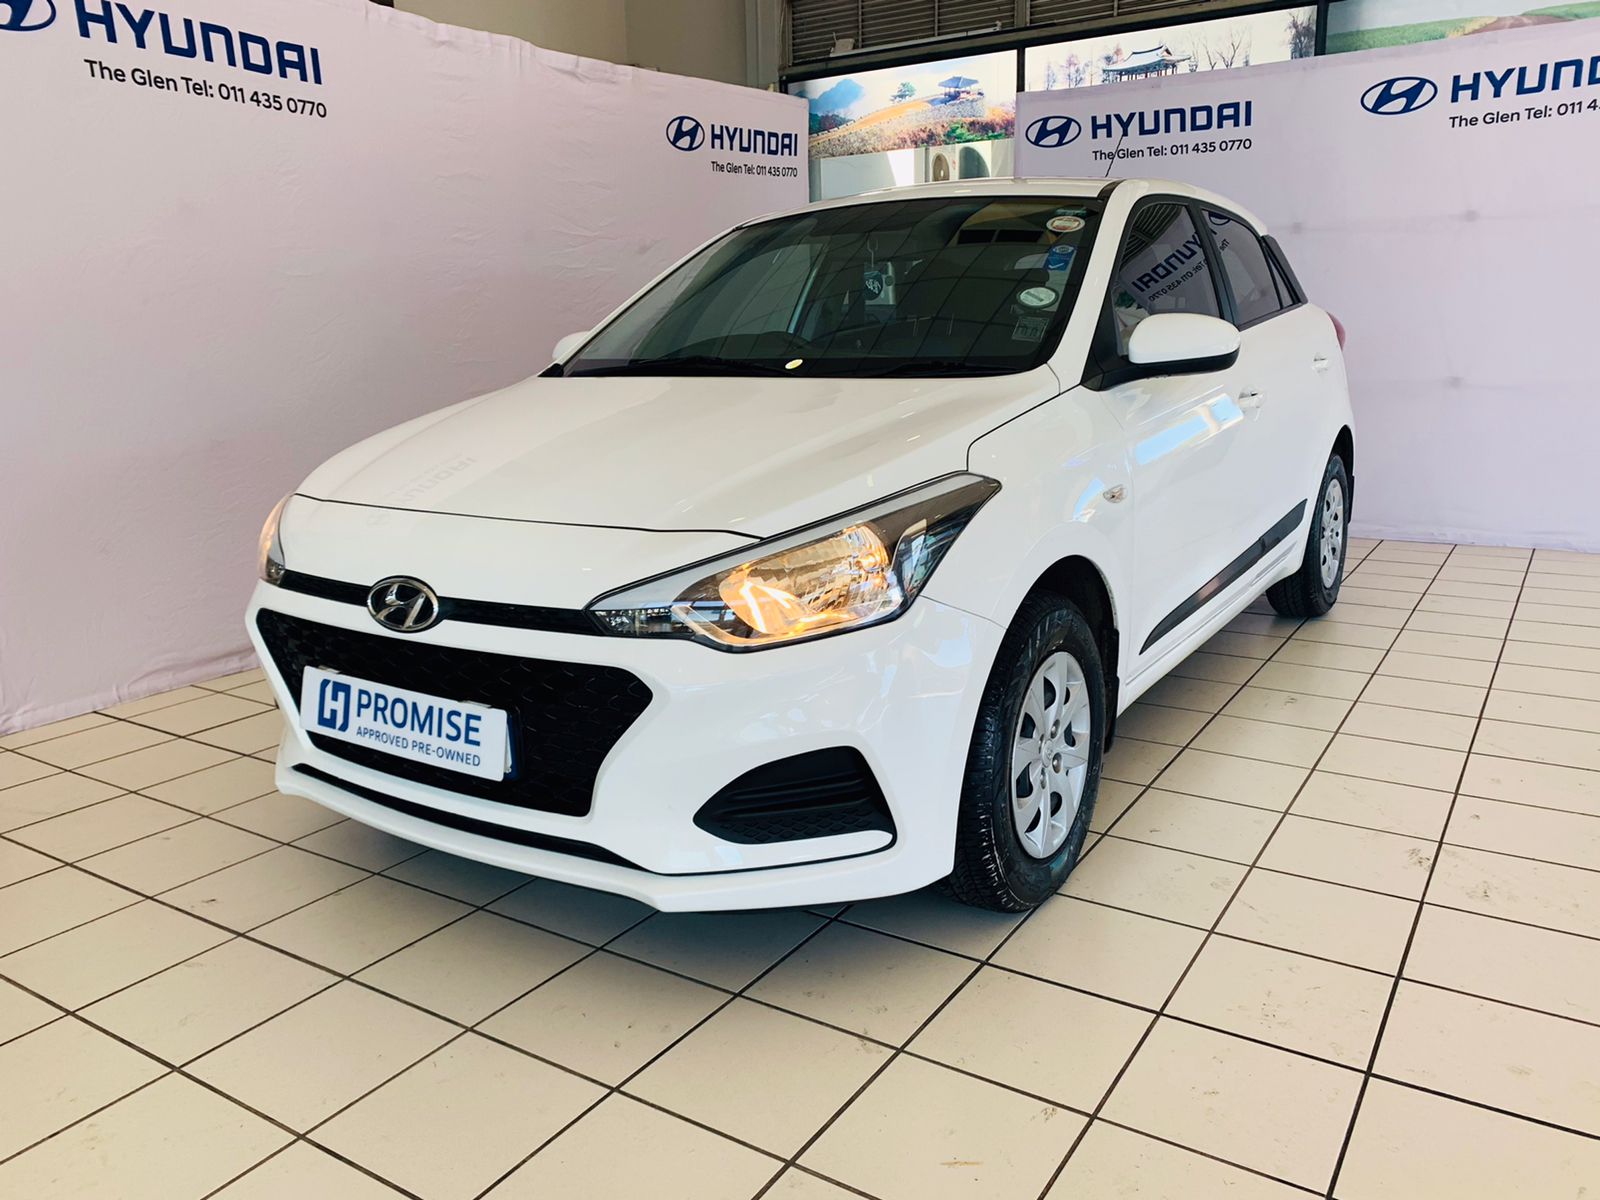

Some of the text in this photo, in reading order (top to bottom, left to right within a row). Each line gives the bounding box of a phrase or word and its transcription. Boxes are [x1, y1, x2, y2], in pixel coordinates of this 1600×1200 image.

[74, 0, 322, 85] HYUNDAI
[83, 58, 328, 118] The Glen Tel: 011 435 0770
[1091, 100, 1252, 140] HYUNDAI
[1449, 97, 1600, 129] The Glen Tel: 011 4
[711, 123, 798, 157] HYUNDAI
[1092, 138, 1252, 161] The Glen Tel: 011 435 0770
[711, 161, 798, 178] The Glen Tel: 011 435 0770
[356, 688, 482, 747] PROMISE
[356, 725, 481, 767] APPROVED PRE-OWNED
